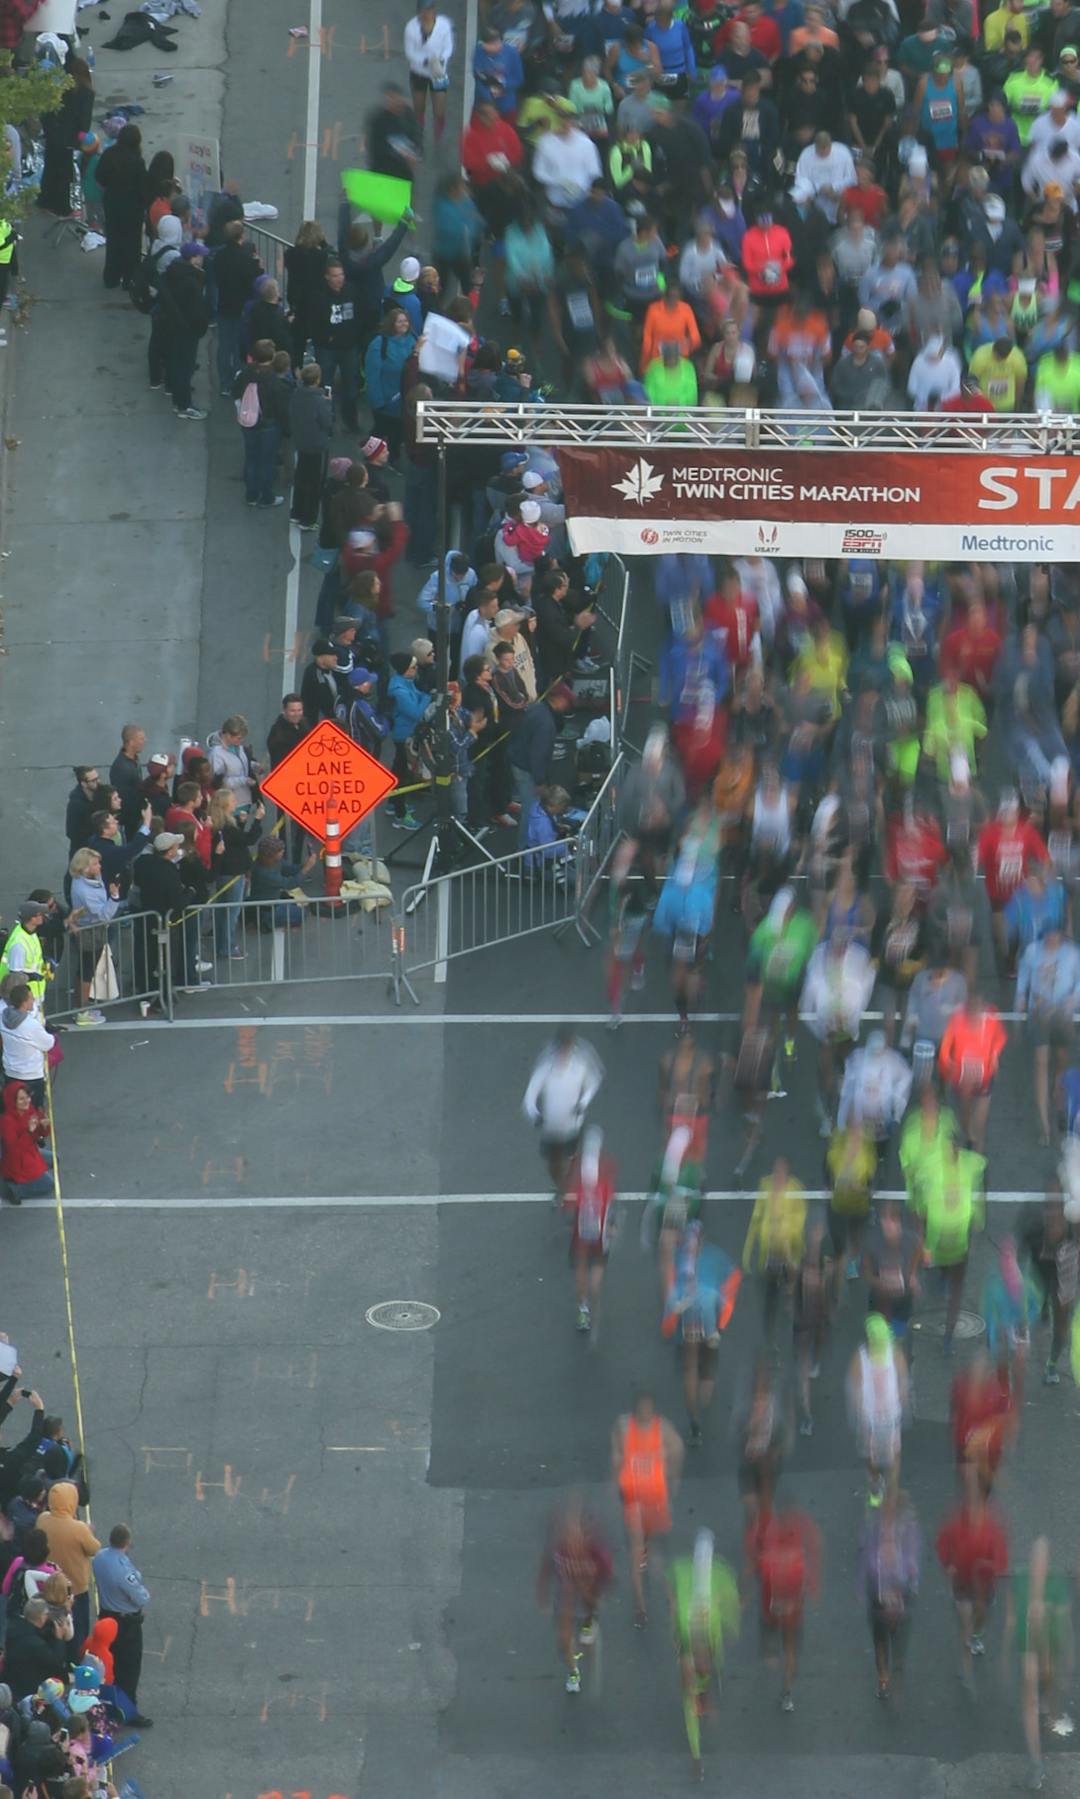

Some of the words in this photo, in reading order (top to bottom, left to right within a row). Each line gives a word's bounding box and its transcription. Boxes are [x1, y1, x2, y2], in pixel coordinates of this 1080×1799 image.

[672, 467, 783, 482] MEDTRONIC
[672, 483, 724, 499] TWIN
[729, 484, 794, 500] CITIES
[799, 486, 921, 502] MARATHON
[844, 529, 874, 538] 1500
[961, 536, 1054, 551] Medtronic
[306, 761, 352, 775] LANE
[295, 780, 365, 796] CLOSED
[300, 800, 361, 815] AHAD
